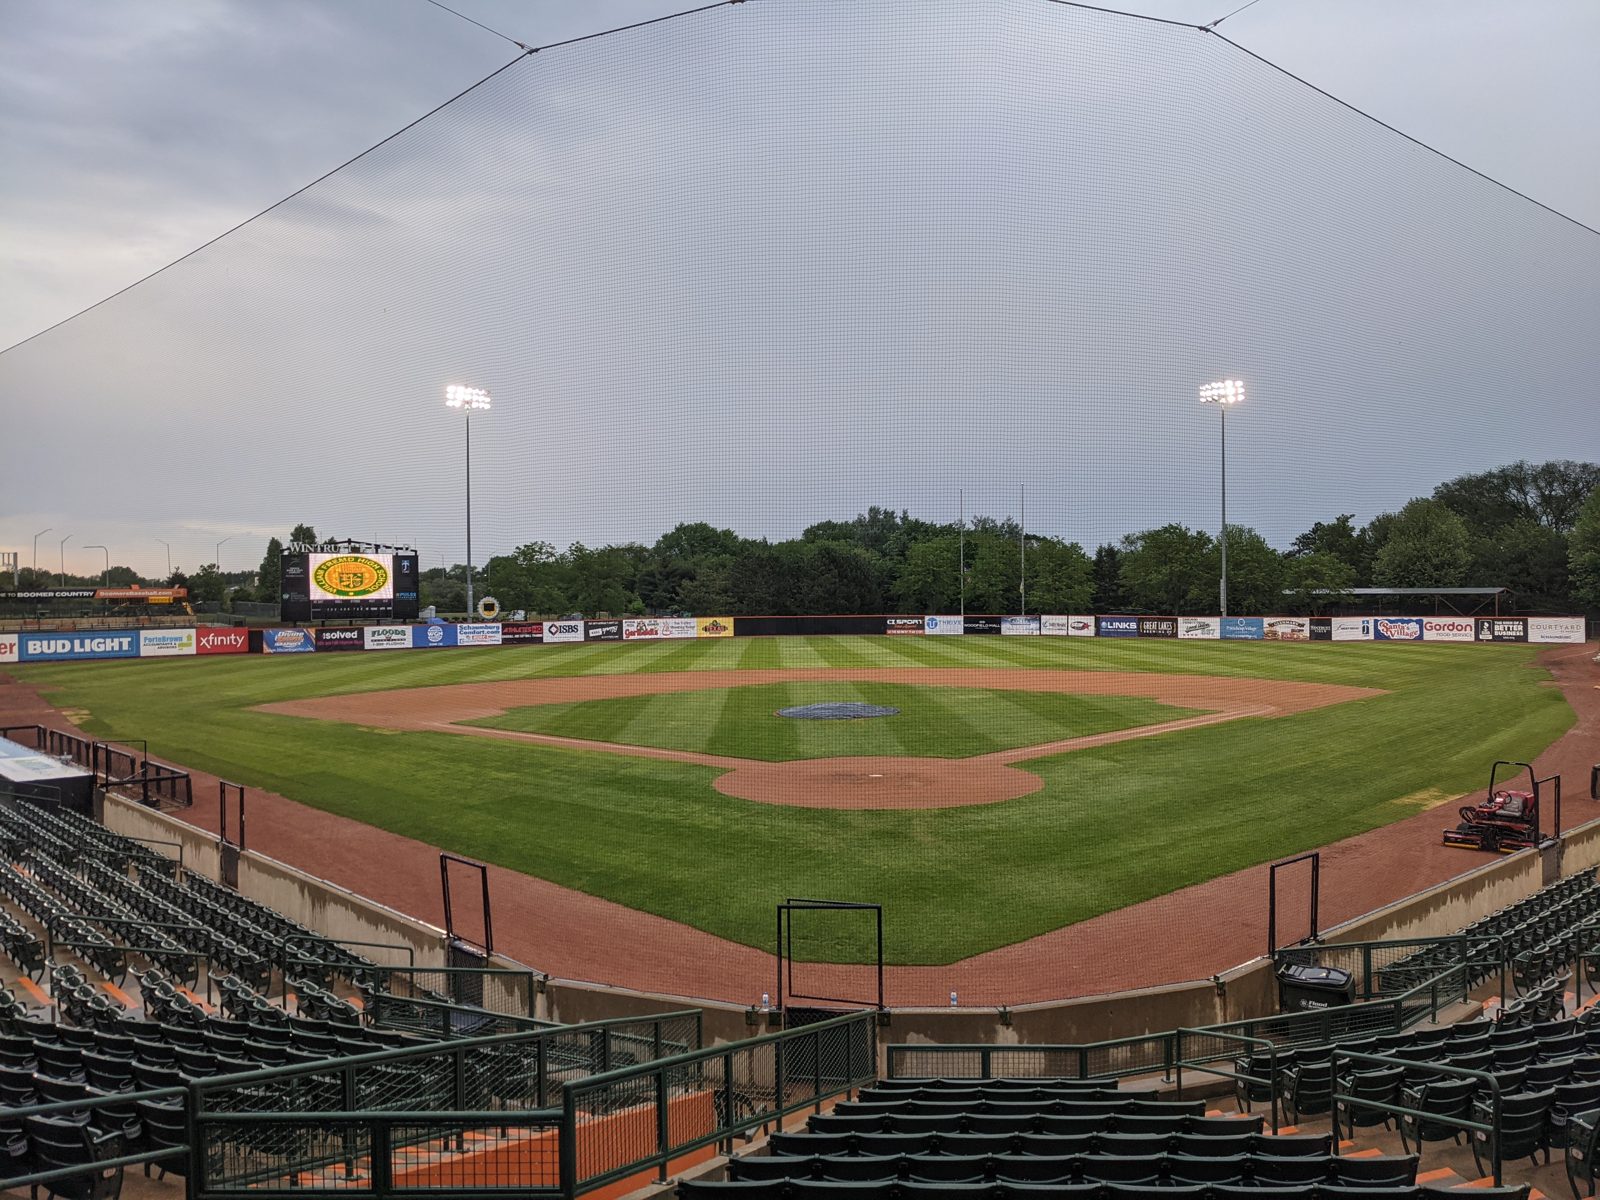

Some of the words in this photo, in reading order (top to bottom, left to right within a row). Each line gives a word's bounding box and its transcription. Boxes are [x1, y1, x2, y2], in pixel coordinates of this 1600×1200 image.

[357, 557, 380, 569] HIGH
[459, 624, 500, 632] Schaumburg
[559, 624, 579, 634] ISBS
[1107, 621, 1137, 629] LINKS
[1143, 621, 1158, 630] GREAT
[1158, 621, 1172, 631] LAKES
[1424, 621, 1473, 632] Gordon
[371, 629, 407, 638] FLOODS
[1389, 628, 1418, 638] Village
[28, 639, 71, 655] BUD
[74, 637, 131, 653] LIGHT
[200, 633, 245, 649] xfinity
